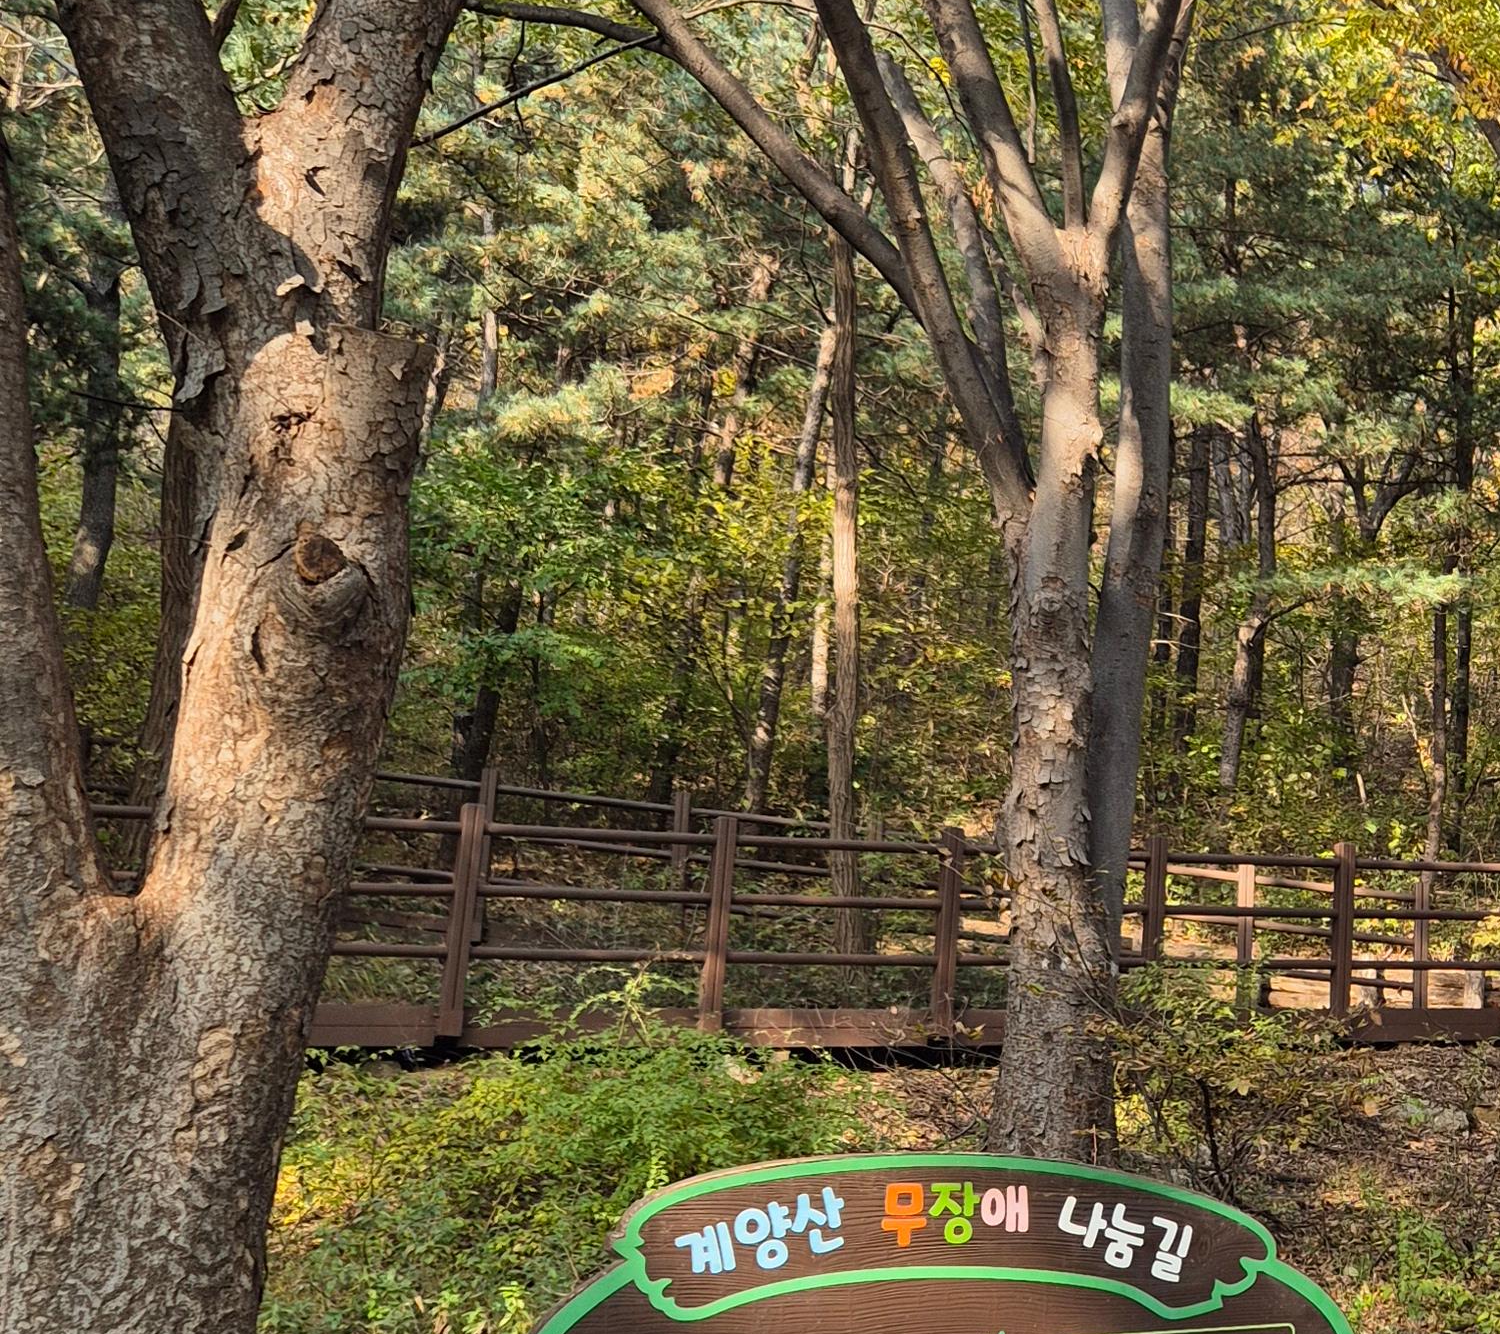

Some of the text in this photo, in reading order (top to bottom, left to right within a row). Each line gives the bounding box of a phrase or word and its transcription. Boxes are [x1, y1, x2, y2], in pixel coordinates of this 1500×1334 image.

[675, 1182, 1194, 1283] 계양산 무장애 나눔길
